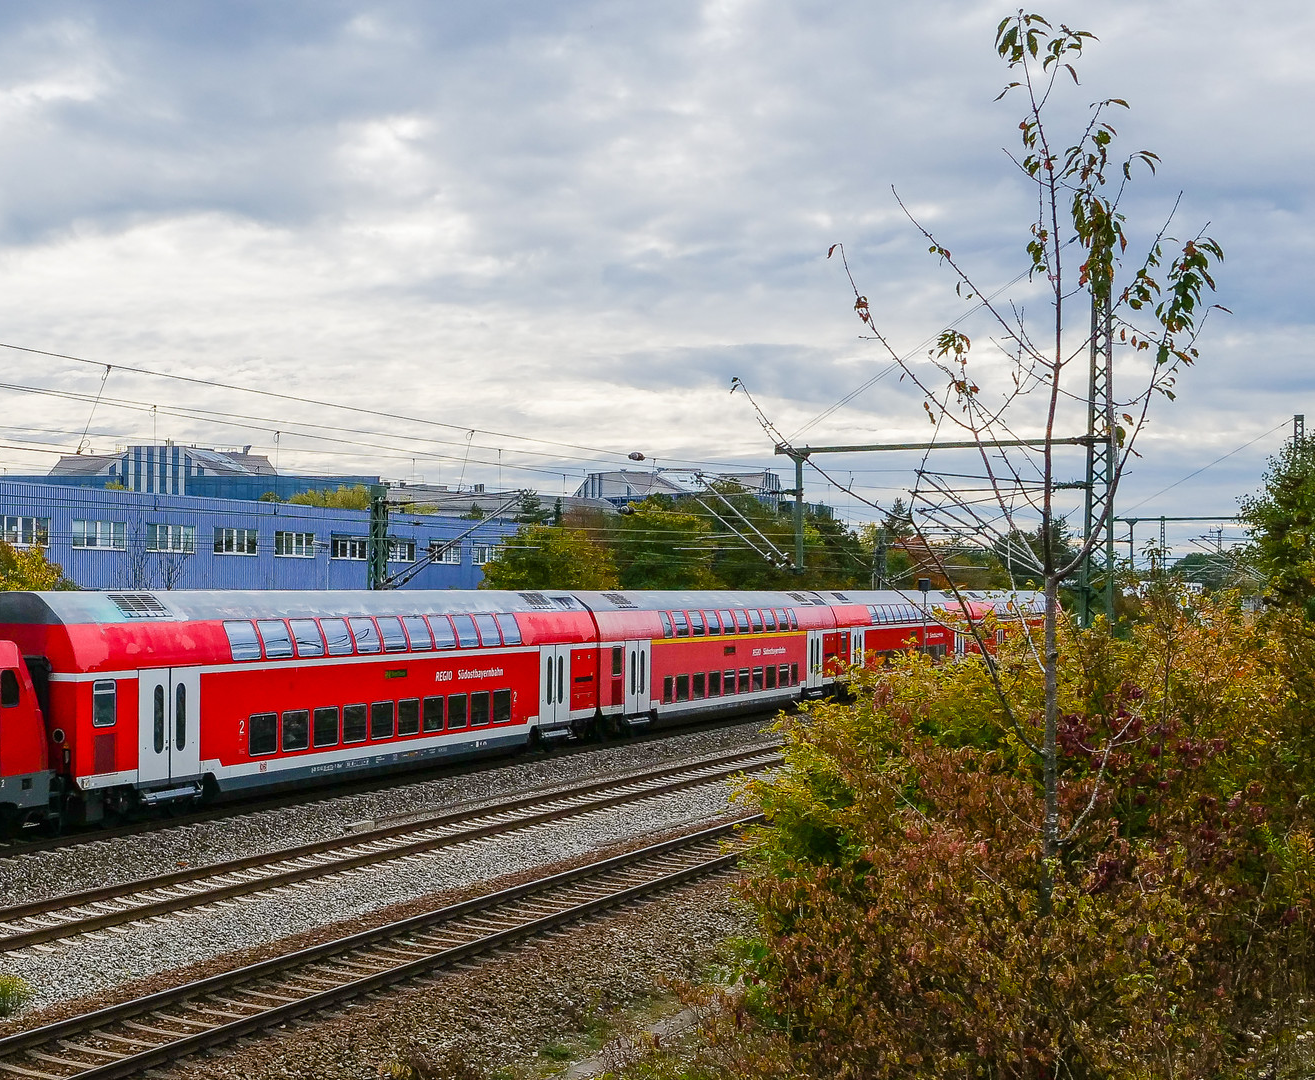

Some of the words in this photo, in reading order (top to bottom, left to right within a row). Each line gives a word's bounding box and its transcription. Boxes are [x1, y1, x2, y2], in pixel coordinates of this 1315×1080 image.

[435, 670, 453, 682] REGIO
[457, 667, 504, 680] Südostbayernbahn
[513, 691, 518, 702] 2
[239, 720, 245, 733] 2
